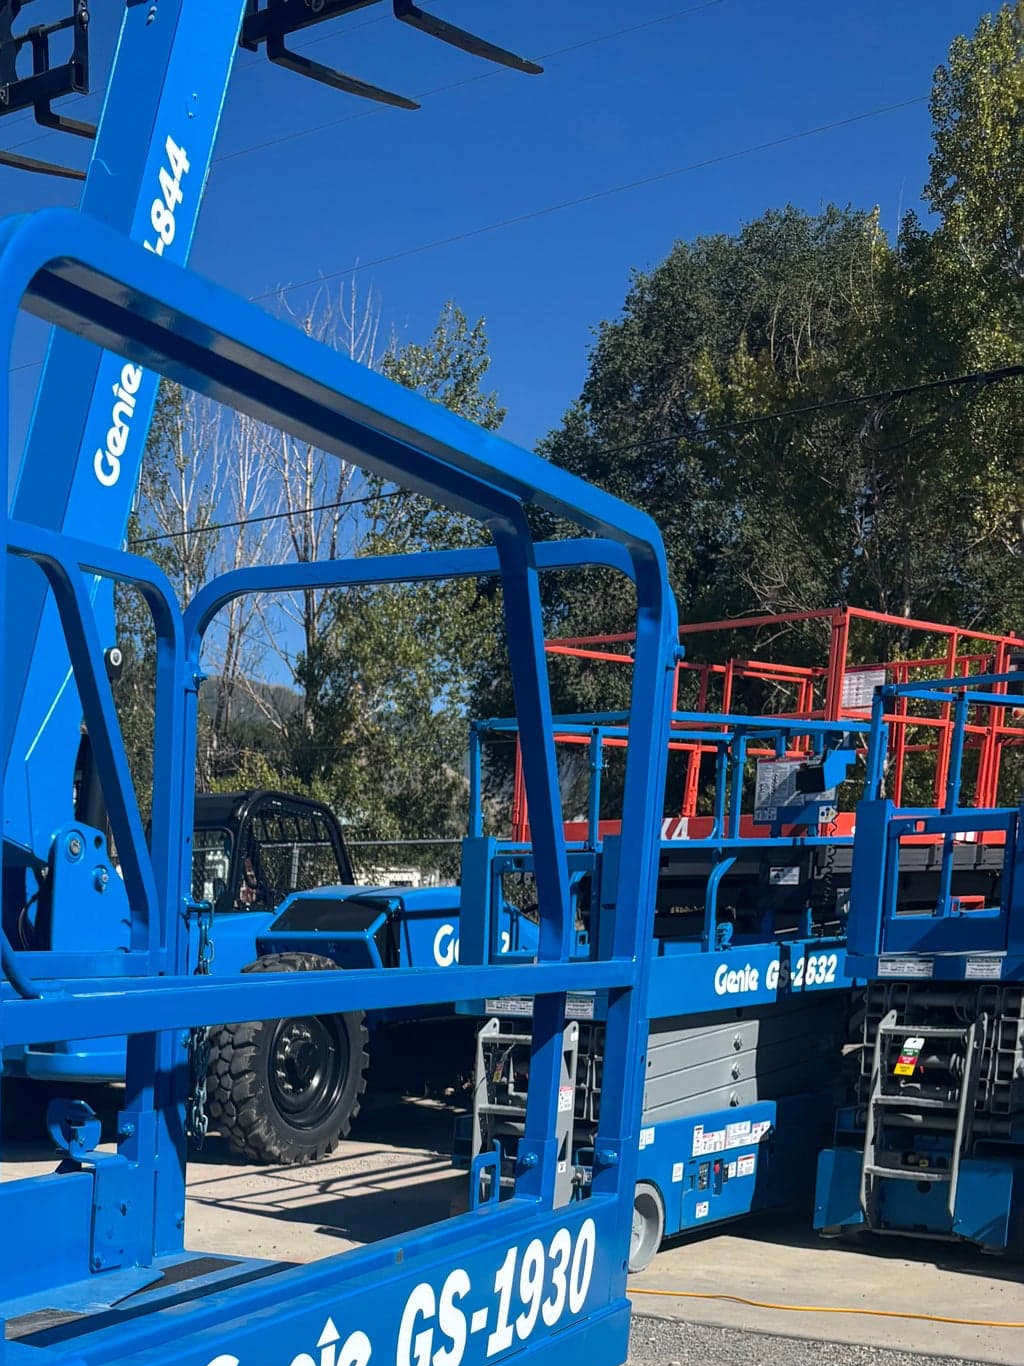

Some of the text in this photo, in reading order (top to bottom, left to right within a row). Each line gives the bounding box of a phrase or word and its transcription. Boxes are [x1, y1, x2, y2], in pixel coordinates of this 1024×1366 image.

[144, 135, 190, 256] -844
[94, 363, 142, 487] Genie
[714, 963, 759, 996] Genie
[766, 954, 837, 990] GS-2632
